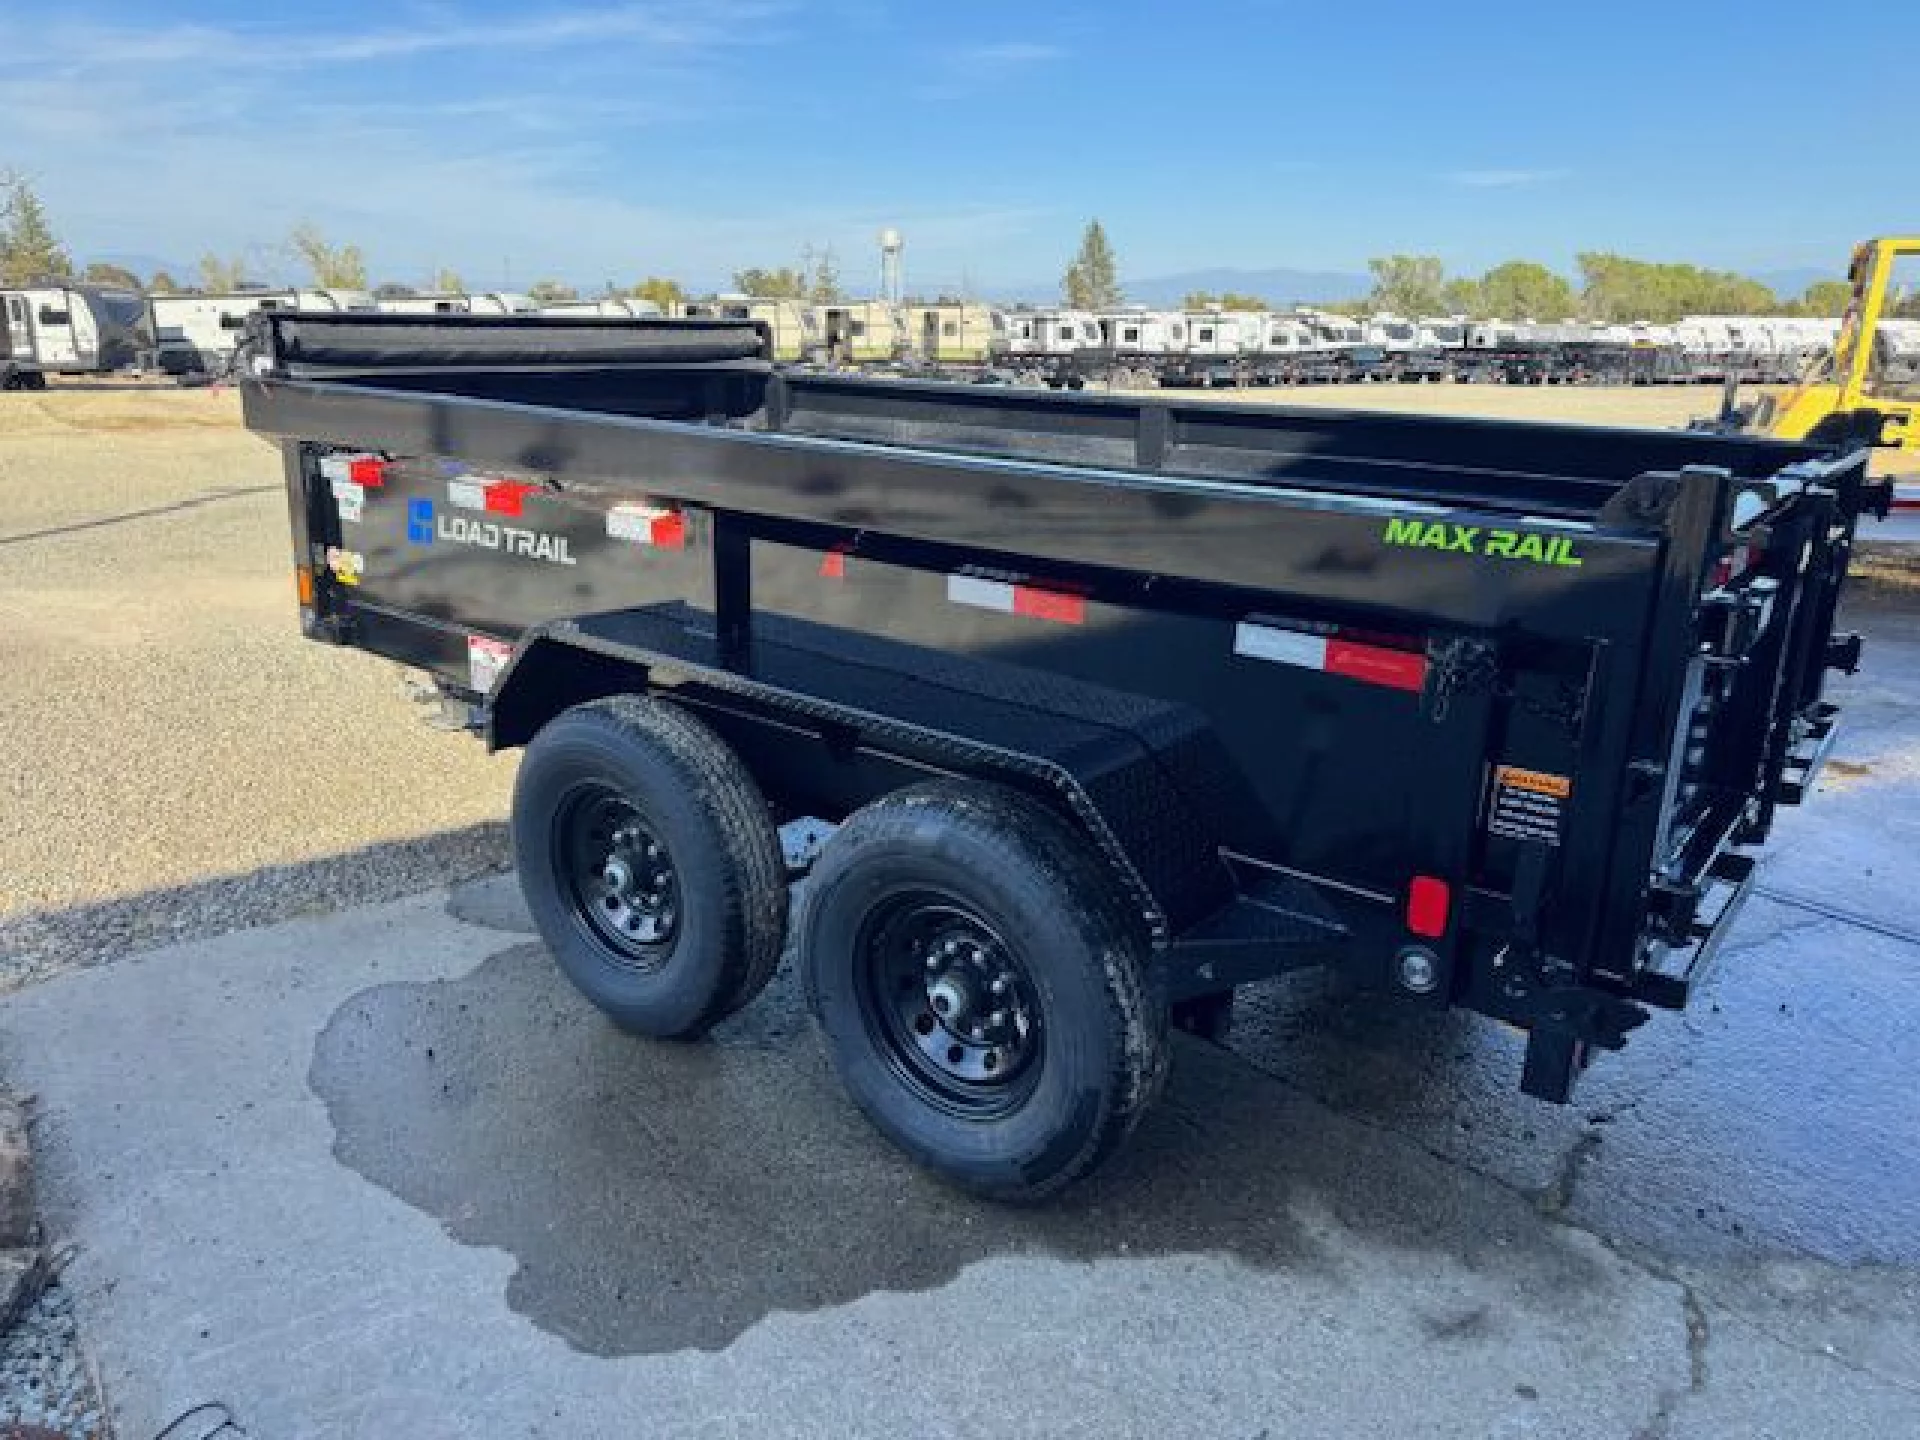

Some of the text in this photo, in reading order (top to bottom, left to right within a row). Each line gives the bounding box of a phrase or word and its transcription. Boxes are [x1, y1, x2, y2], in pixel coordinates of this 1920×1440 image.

[437, 515, 577, 565] LOAD TRAIL
[1383, 518, 1583, 567] MAX RAIL
